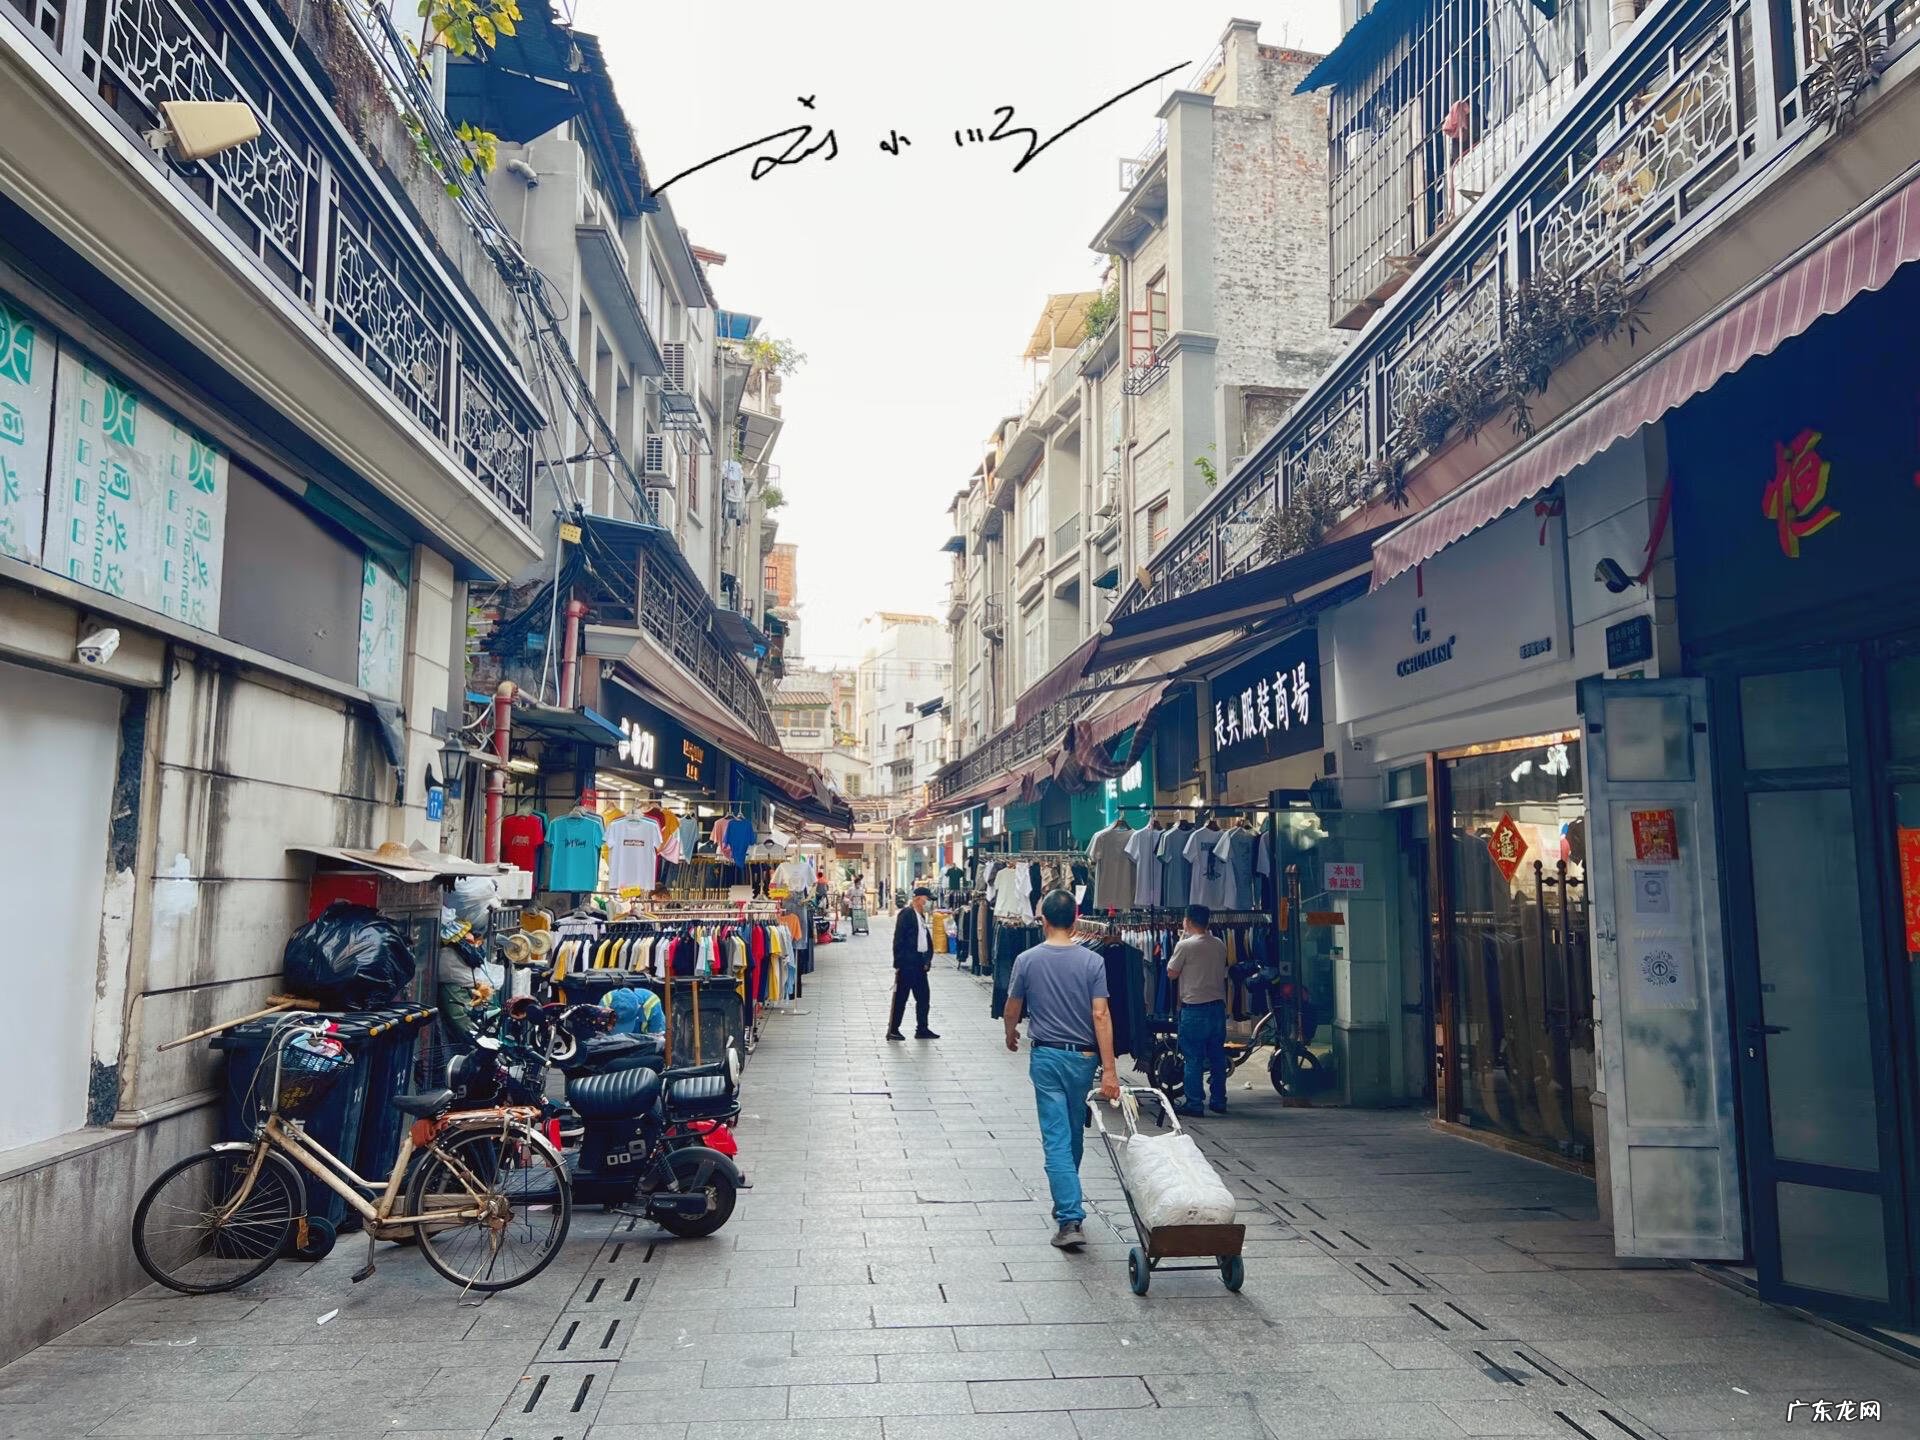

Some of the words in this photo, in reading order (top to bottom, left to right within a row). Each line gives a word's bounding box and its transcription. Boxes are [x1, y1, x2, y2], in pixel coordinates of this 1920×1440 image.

[1214, 661, 1311, 752] 長興服裝商場
[606, 1139, 647, 1166] 009
